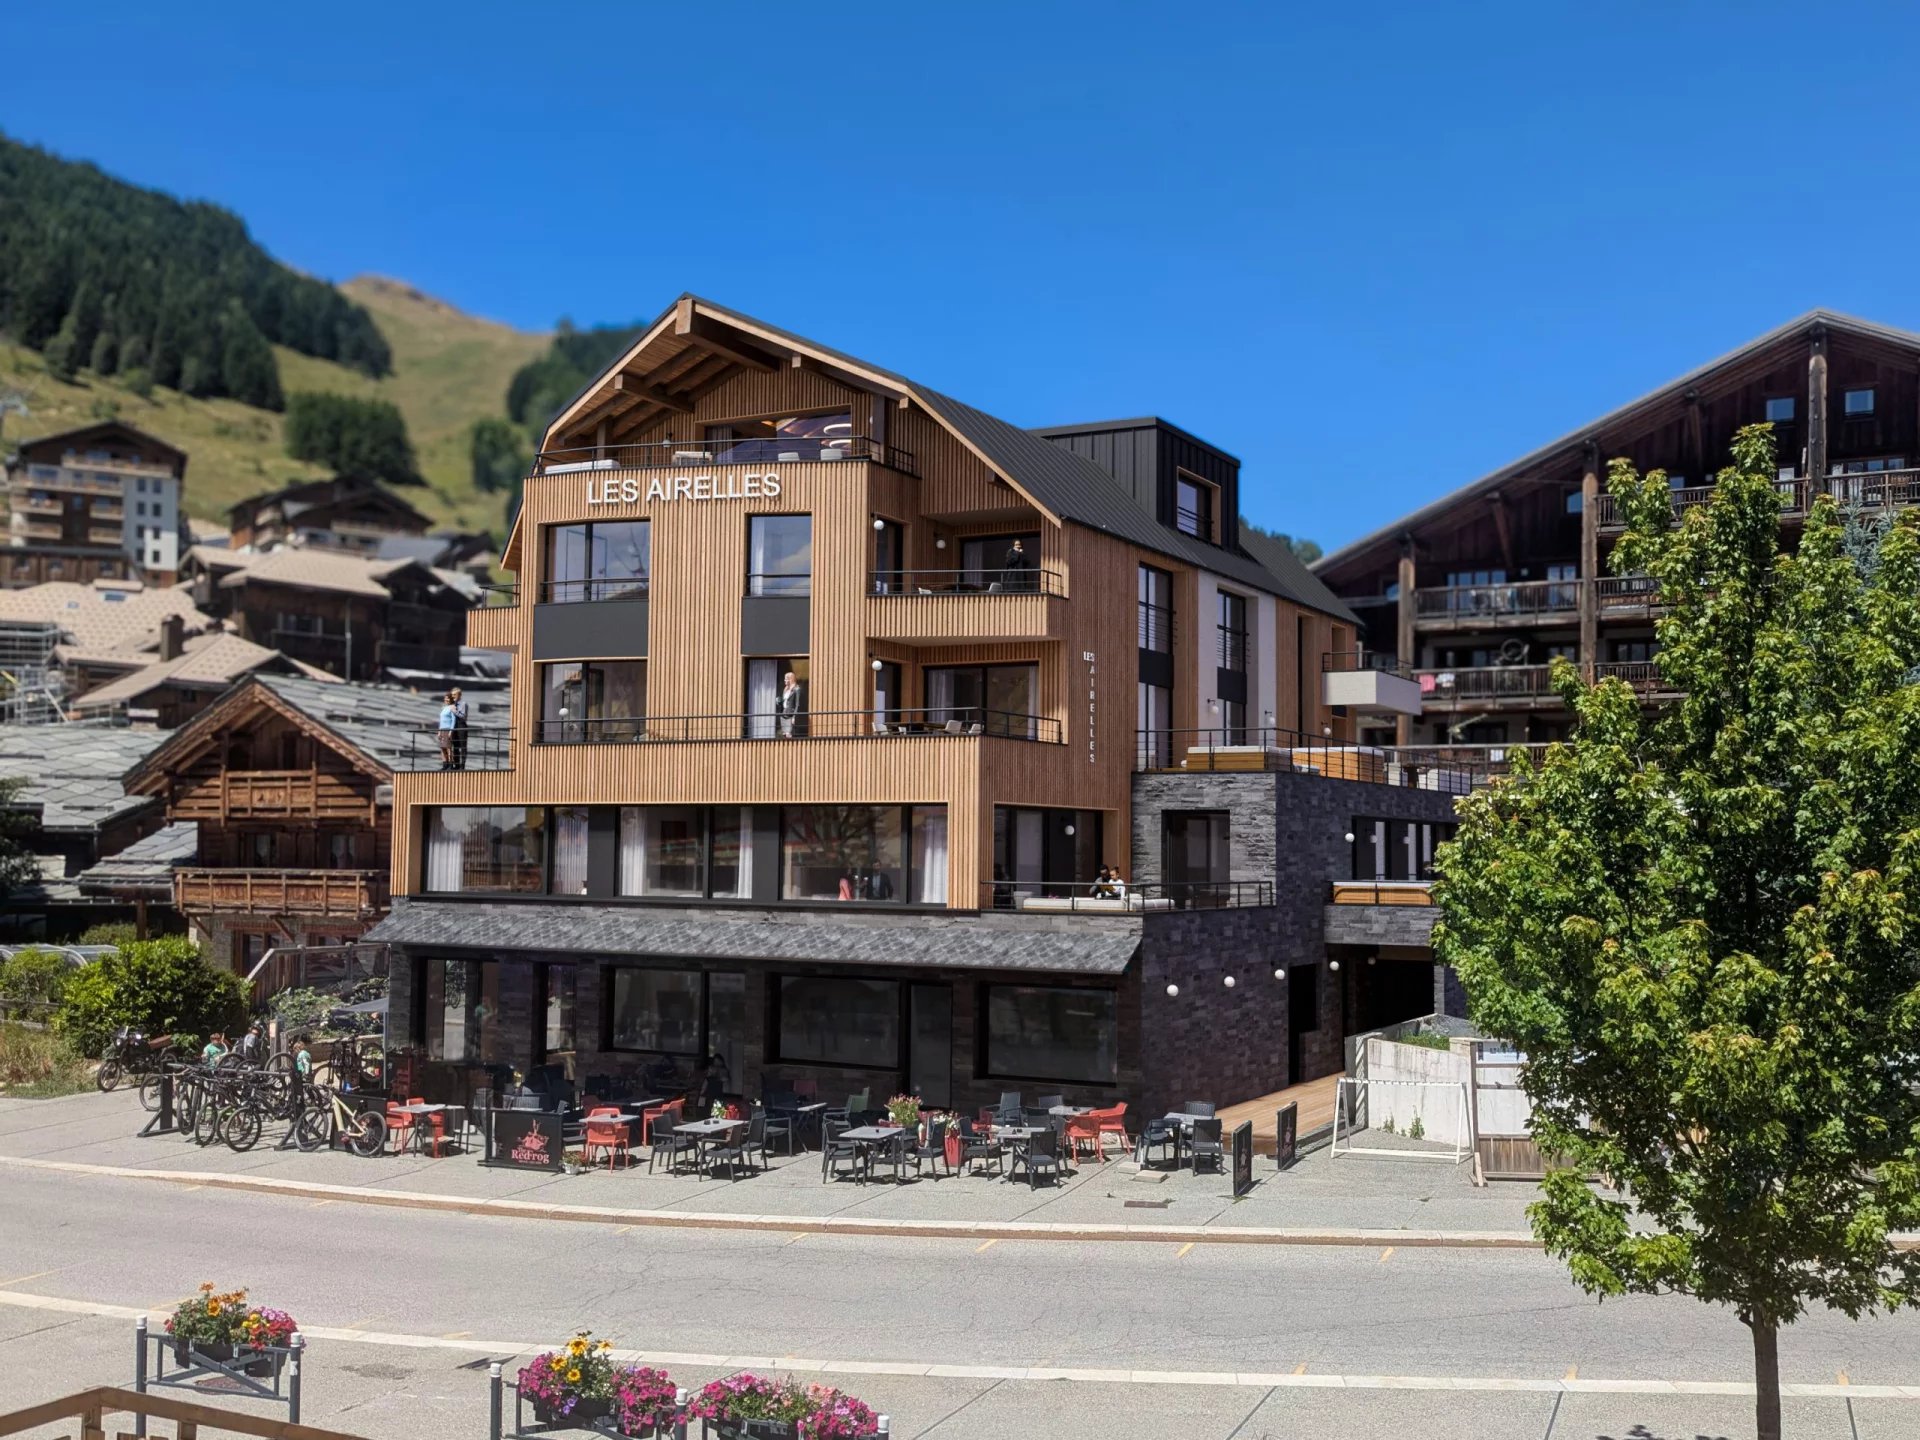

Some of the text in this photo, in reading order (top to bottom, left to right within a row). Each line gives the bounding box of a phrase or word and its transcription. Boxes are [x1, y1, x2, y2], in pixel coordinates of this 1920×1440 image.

[588, 473, 781, 503] LES AIRELLES
[1083, 651, 1095, 661] LES
